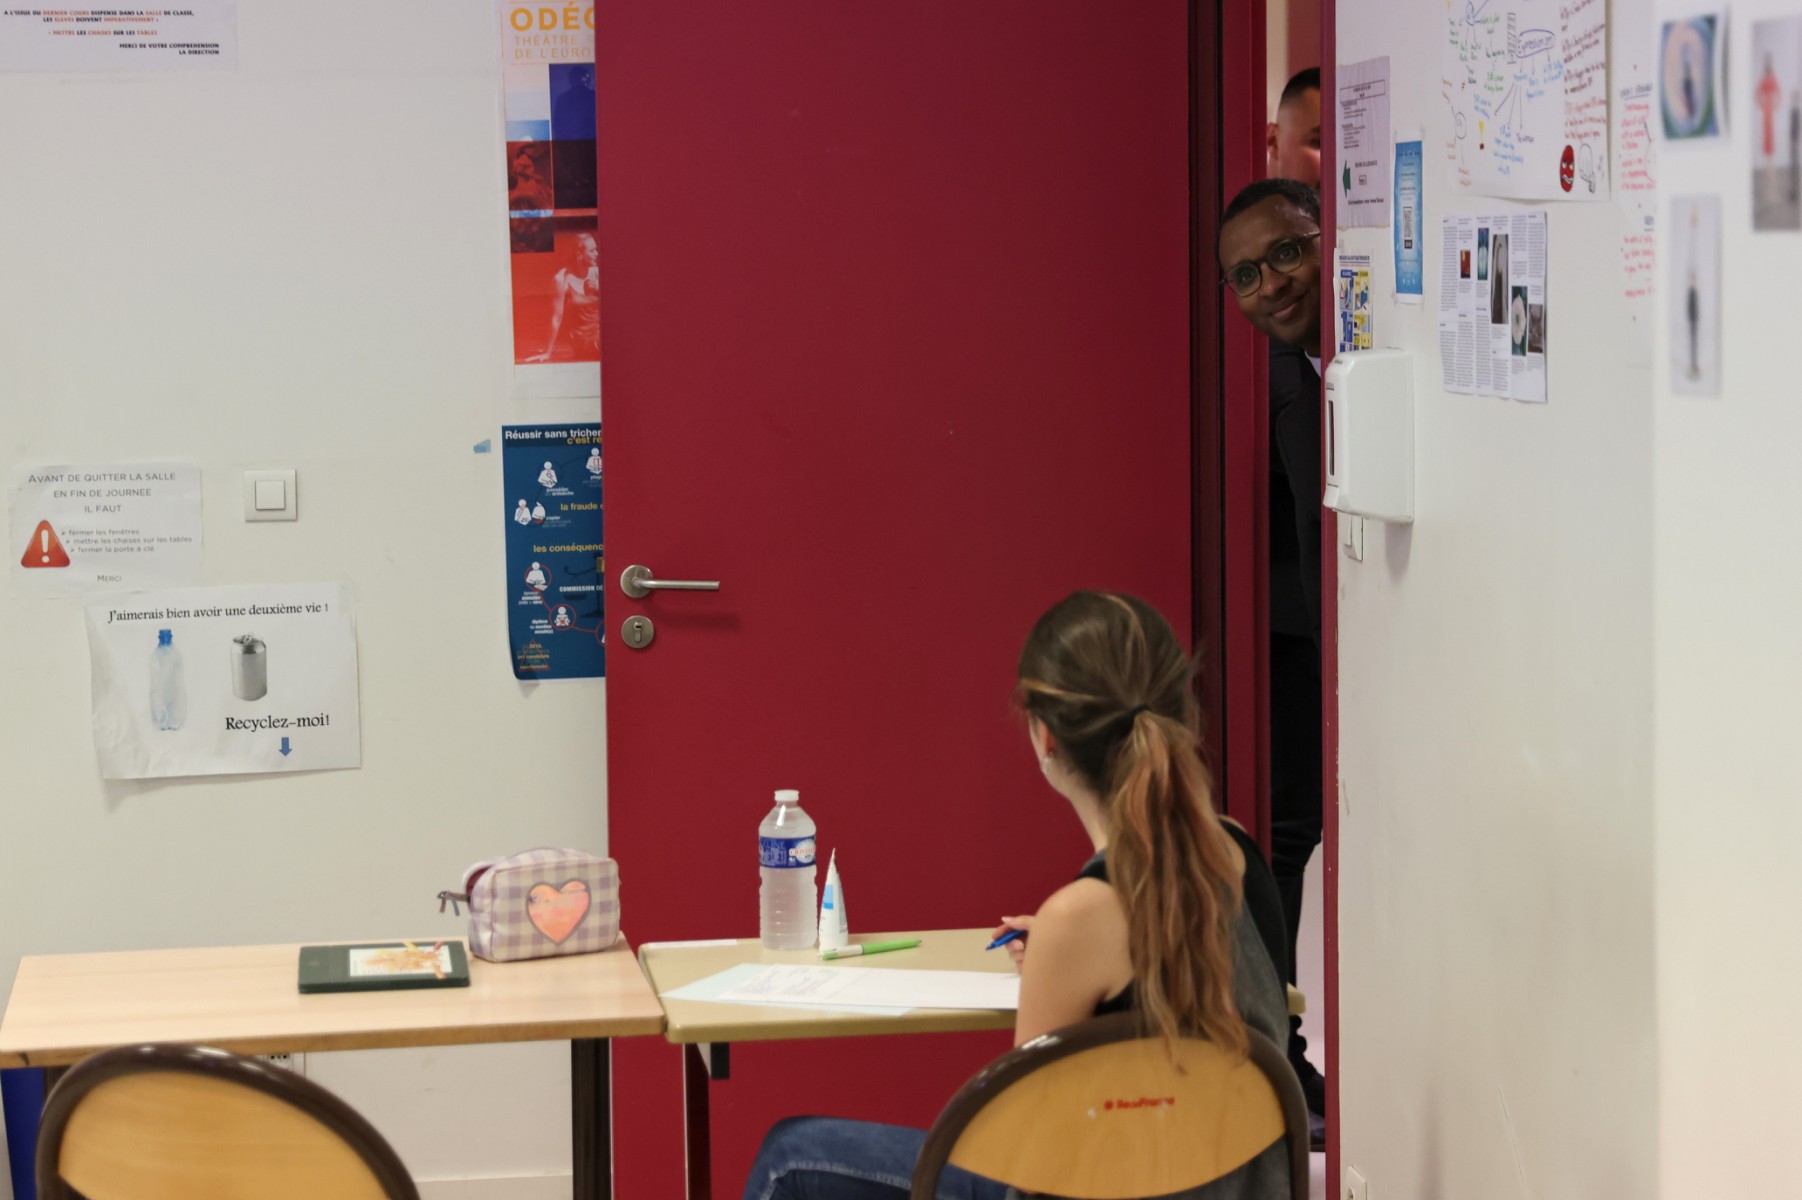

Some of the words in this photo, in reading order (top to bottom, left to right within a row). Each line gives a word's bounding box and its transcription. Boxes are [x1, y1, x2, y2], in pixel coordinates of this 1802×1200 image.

[510, 0, 595, 31] ODÉO
[515, 48, 533, 59] DE
[505, 430, 542, 440] Réussir
[567, 436, 590, 445] c'est
[592, 435, 602, 444] ré
[67, 474, 81, 482] DE
[84, 473, 127, 483] QUITTER
[129, 473, 143, 481] LA
[145, 472, 176, 481] SALLE
[53, 490, 67, 498] EN
[70, 489, 86, 497] FIN
[89, 489, 103, 498] DE
[84, 505, 93, 513] IL
[95, 504, 122, 513] FAUT
[560, 503, 568, 511] la
[570, 502, 598, 511] fraude
[113, 546, 135, 554] porte
[533, 545, 548, 553] les
[548, 543, 604, 554] conséquenc
[559, 585, 596, 593] COMMISSION
[108, 608, 164, 624] J'aimerais
[166, 607, 191, 619] bien
[193, 606, 223, 618] avoir
[225, 607, 246, 617] une
[248, 603, 303, 616] deuxième
[305, 602, 322, 613] vie
